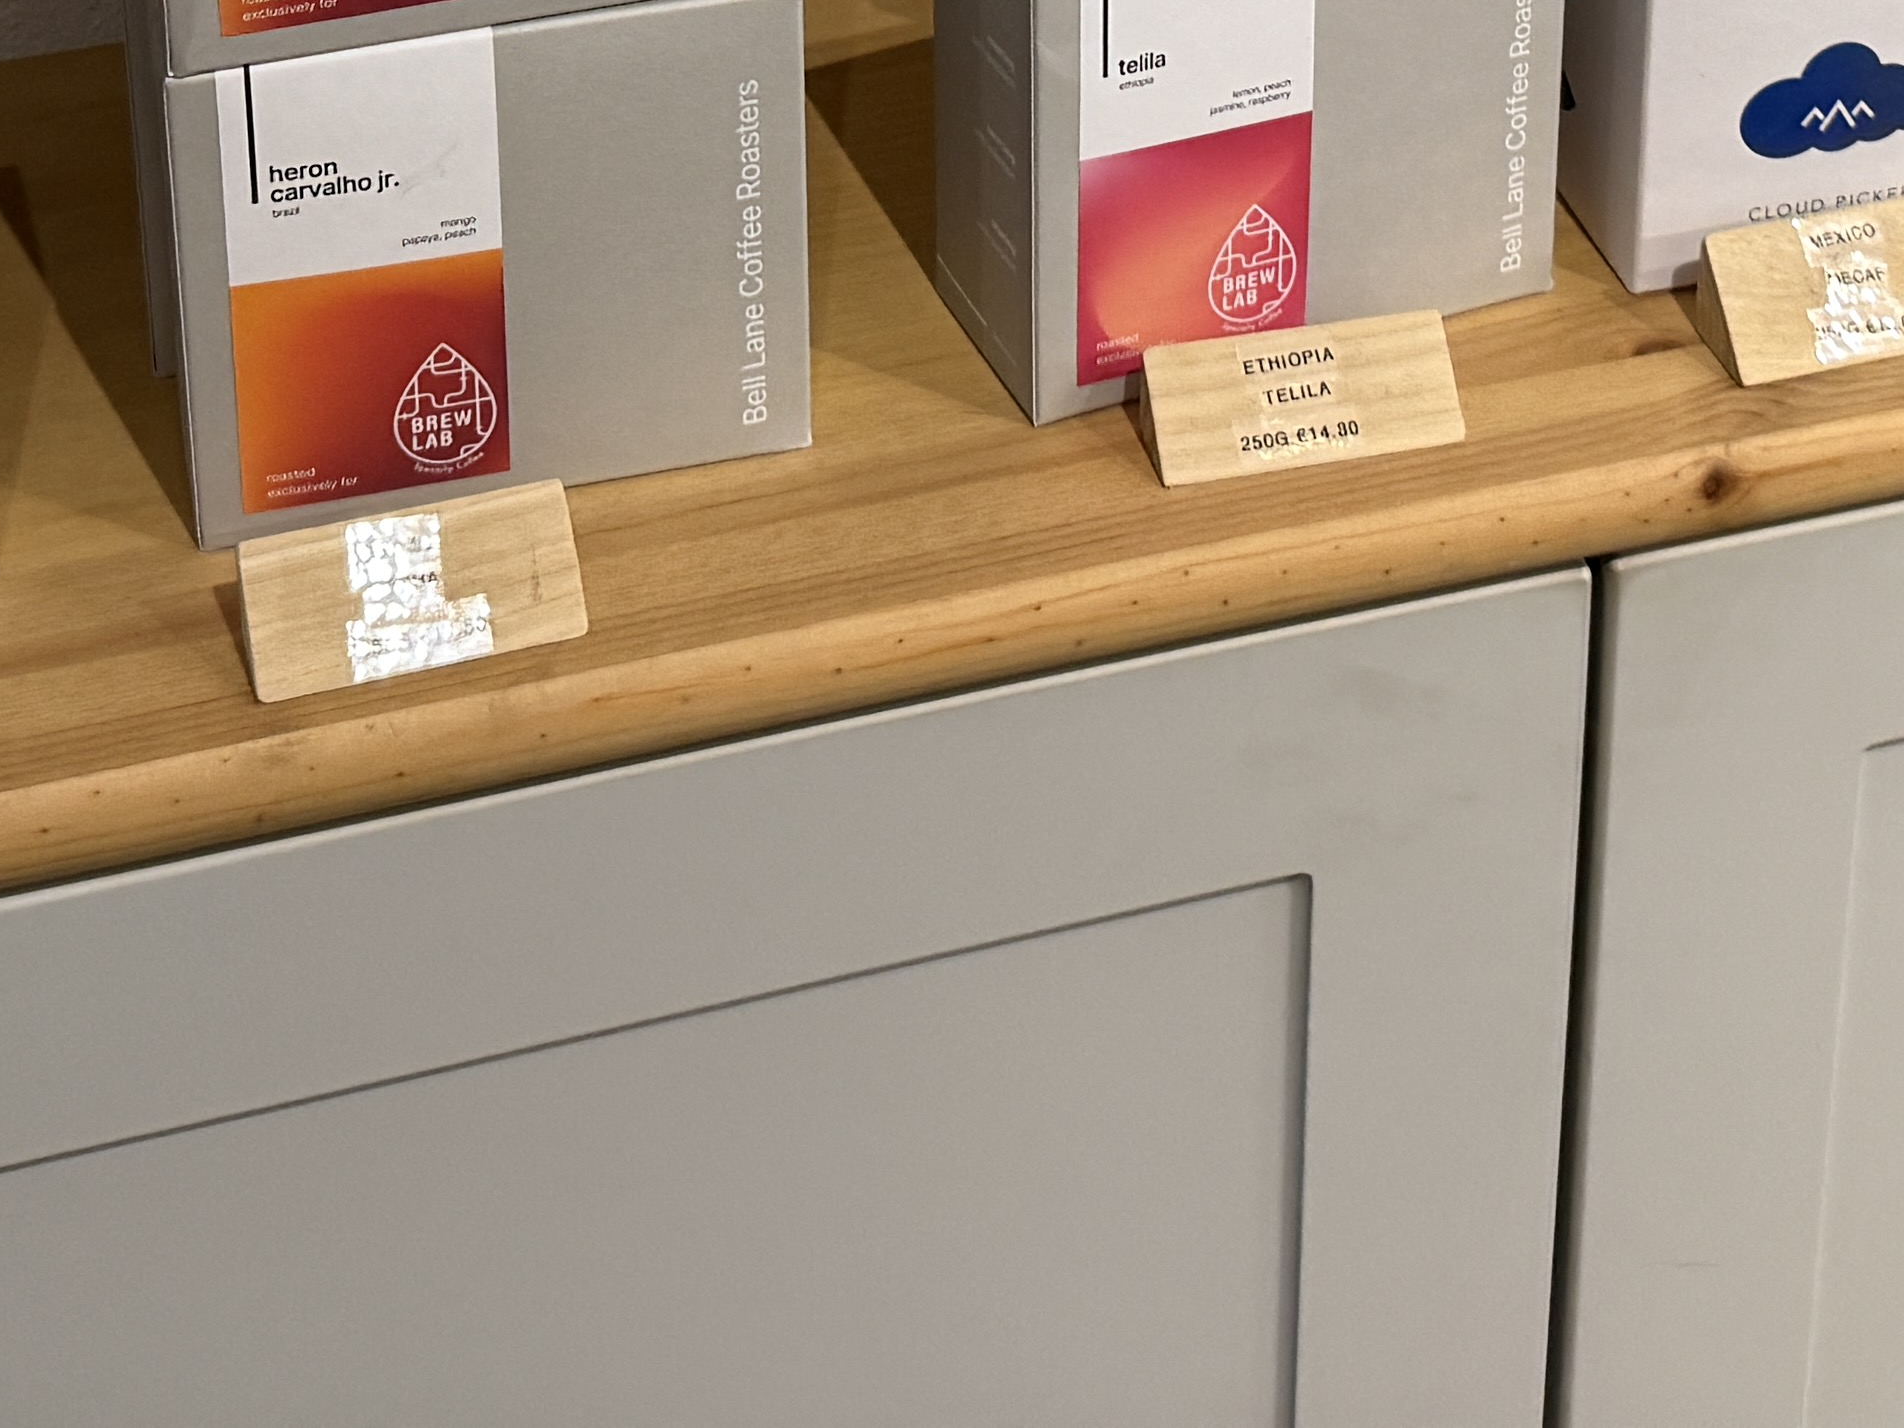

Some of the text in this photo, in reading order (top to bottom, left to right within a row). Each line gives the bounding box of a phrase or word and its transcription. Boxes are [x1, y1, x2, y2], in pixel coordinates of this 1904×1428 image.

[242, 1, 316, 21] exclusively
[1119, 52, 1166, 76] telila
[1119, 76, 1154, 90] ethiopia
[1263, 79, 1292, 93] peach
[1248, 91, 1291, 107] raspberry
[1505, 61, 1529, 151] Coffee
[269, 161, 338, 183] heron
[270, 170, 400, 203] carvalho jr.
[1502, 155, 1525, 223] Lane
[1748, 199, 1824, 222] CLOUD
[440, 216, 477, 229] mango
[444, 227, 477, 241] peach
[1809, 223, 1875, 248] MEXICO
[735, 79, 767, 426] Bell Lane Coffee Roasters
[1500, 222, 1522, 274] Bell
[1223, 266, 1275, 293] BREW
[1222, 289, 1257, 312] LAB
[1096, 333, 1139, 351] roasted
[1243, 347, 1334, 375] ETHIOPIA
[1263, 381, 1331, 405] TELILA
[411, 409, 472, 434] BREW
[412, 430, 453, 451] LAB
[1240, 431, 1289, 451] 250G
[266, 467, 316, 483] roasted
[267, 479, 338, 498] exclusively
